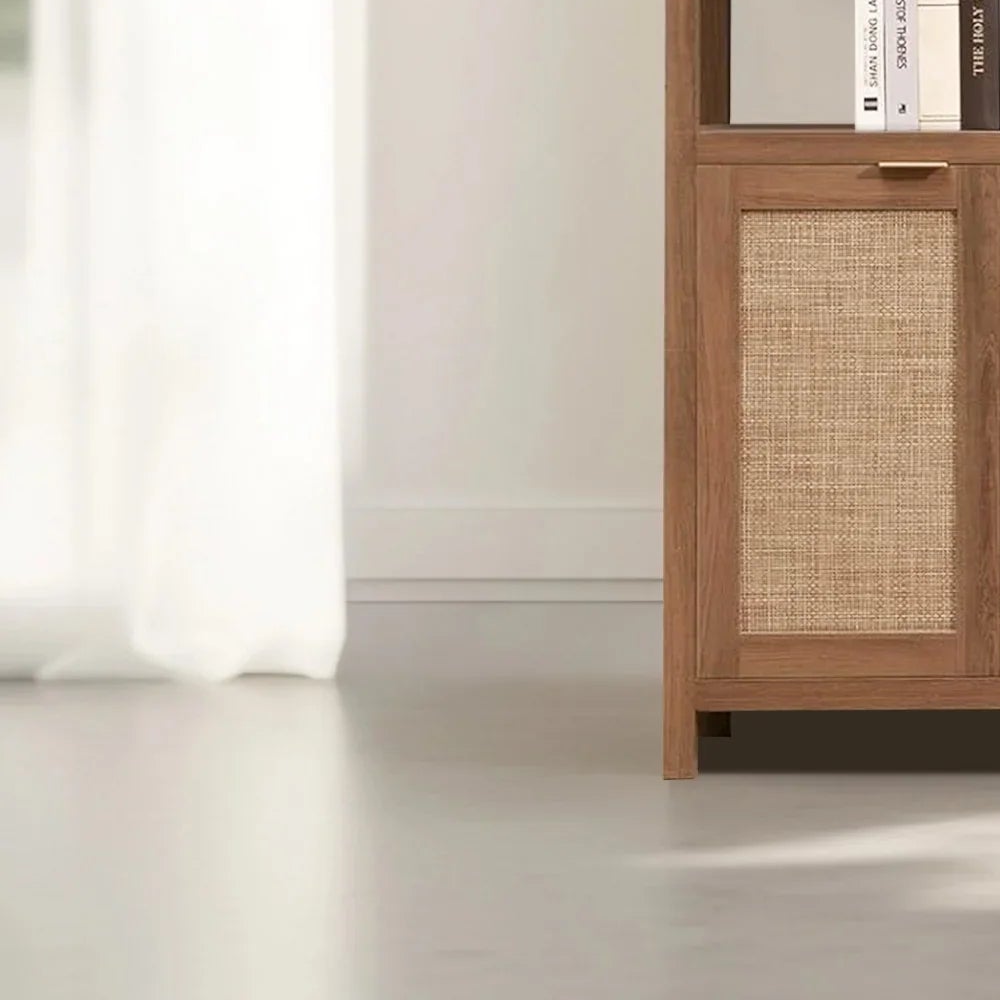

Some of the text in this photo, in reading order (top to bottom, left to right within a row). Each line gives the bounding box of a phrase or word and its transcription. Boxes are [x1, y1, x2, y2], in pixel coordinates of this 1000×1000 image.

[868, 18, 878, 51] DONG
[972, 6, 985, 43] HOLY
[868, 55, 878, 88] SHAN
[972, 46, 985, 76] THE
